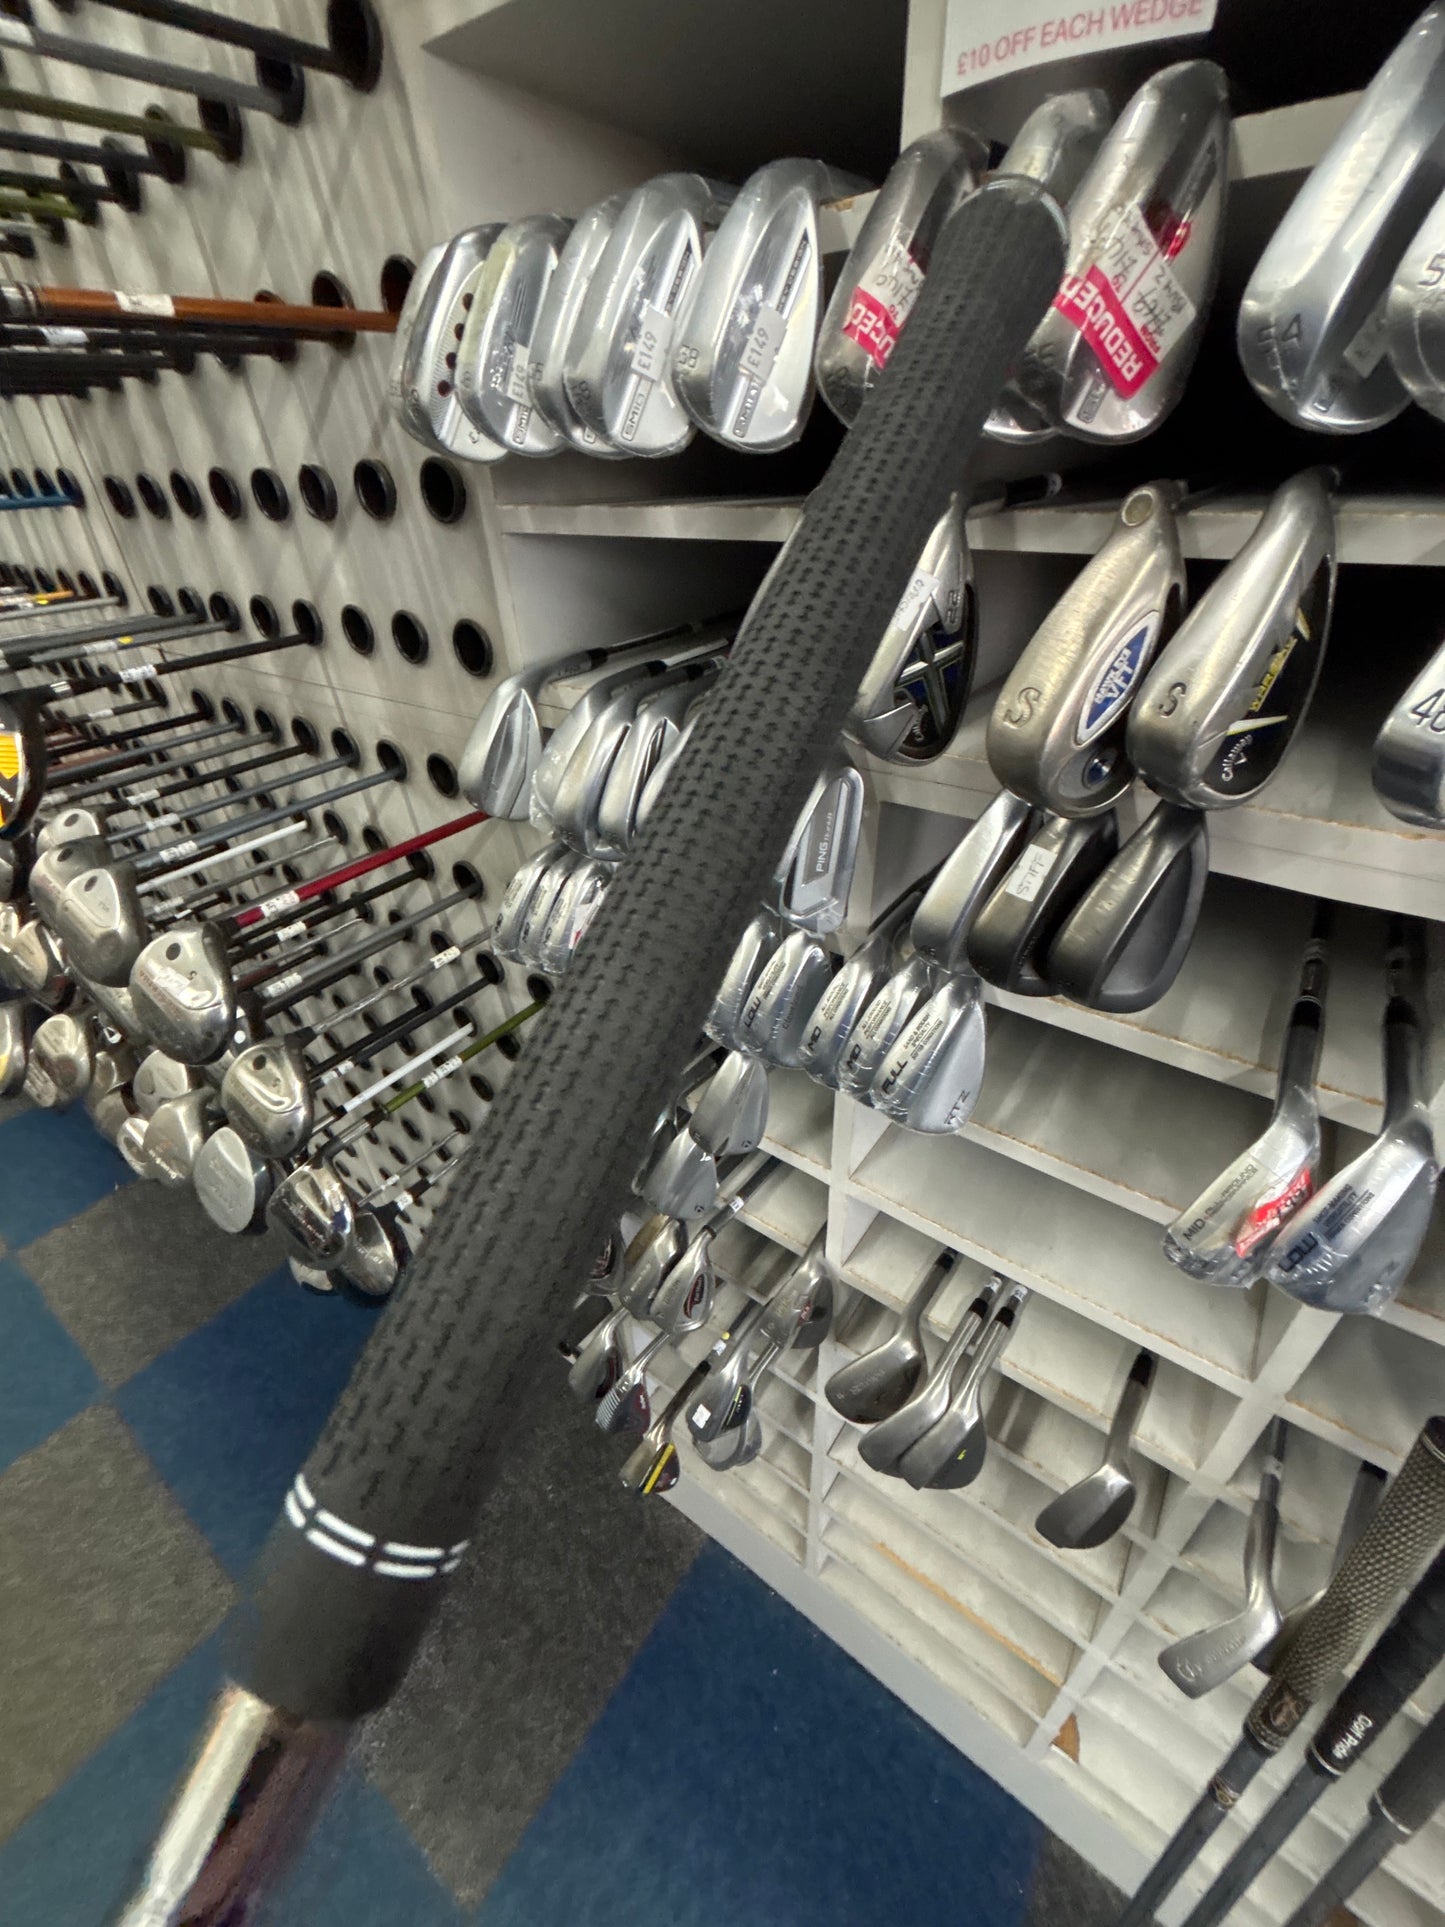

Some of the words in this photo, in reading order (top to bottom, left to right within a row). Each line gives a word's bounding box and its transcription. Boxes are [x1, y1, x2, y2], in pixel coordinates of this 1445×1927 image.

[957, 43, 990, 76] £10
[993, 26, 1036, 61] OFF
[1040, 9, 1105, 48] EACH
[1111, 0, 1204, 31] WEDGE
[746, 326, 770, 368] £149
[852, 302, 896, 359] UCED
[636, 330, 659, 372] £149
[1106, 662, 1134, 699] VFT
[1003, 686, 1042, 729] S
[1158, 682, 1187, 718] S
[1221, 734, 1253, 782] Callaway
[816, 841, 829, 872] PING
[744, 996, 762, 1029] LOW
[881, 1060, 908, 1095] FULL
[1183, 1218, 1206, 1241] MID
[1279, 1232, 1319, 1273] LOW
[1350, 1714, 1373, 1739] Golf
[1332, 1732, 1359, 1760] Pride
